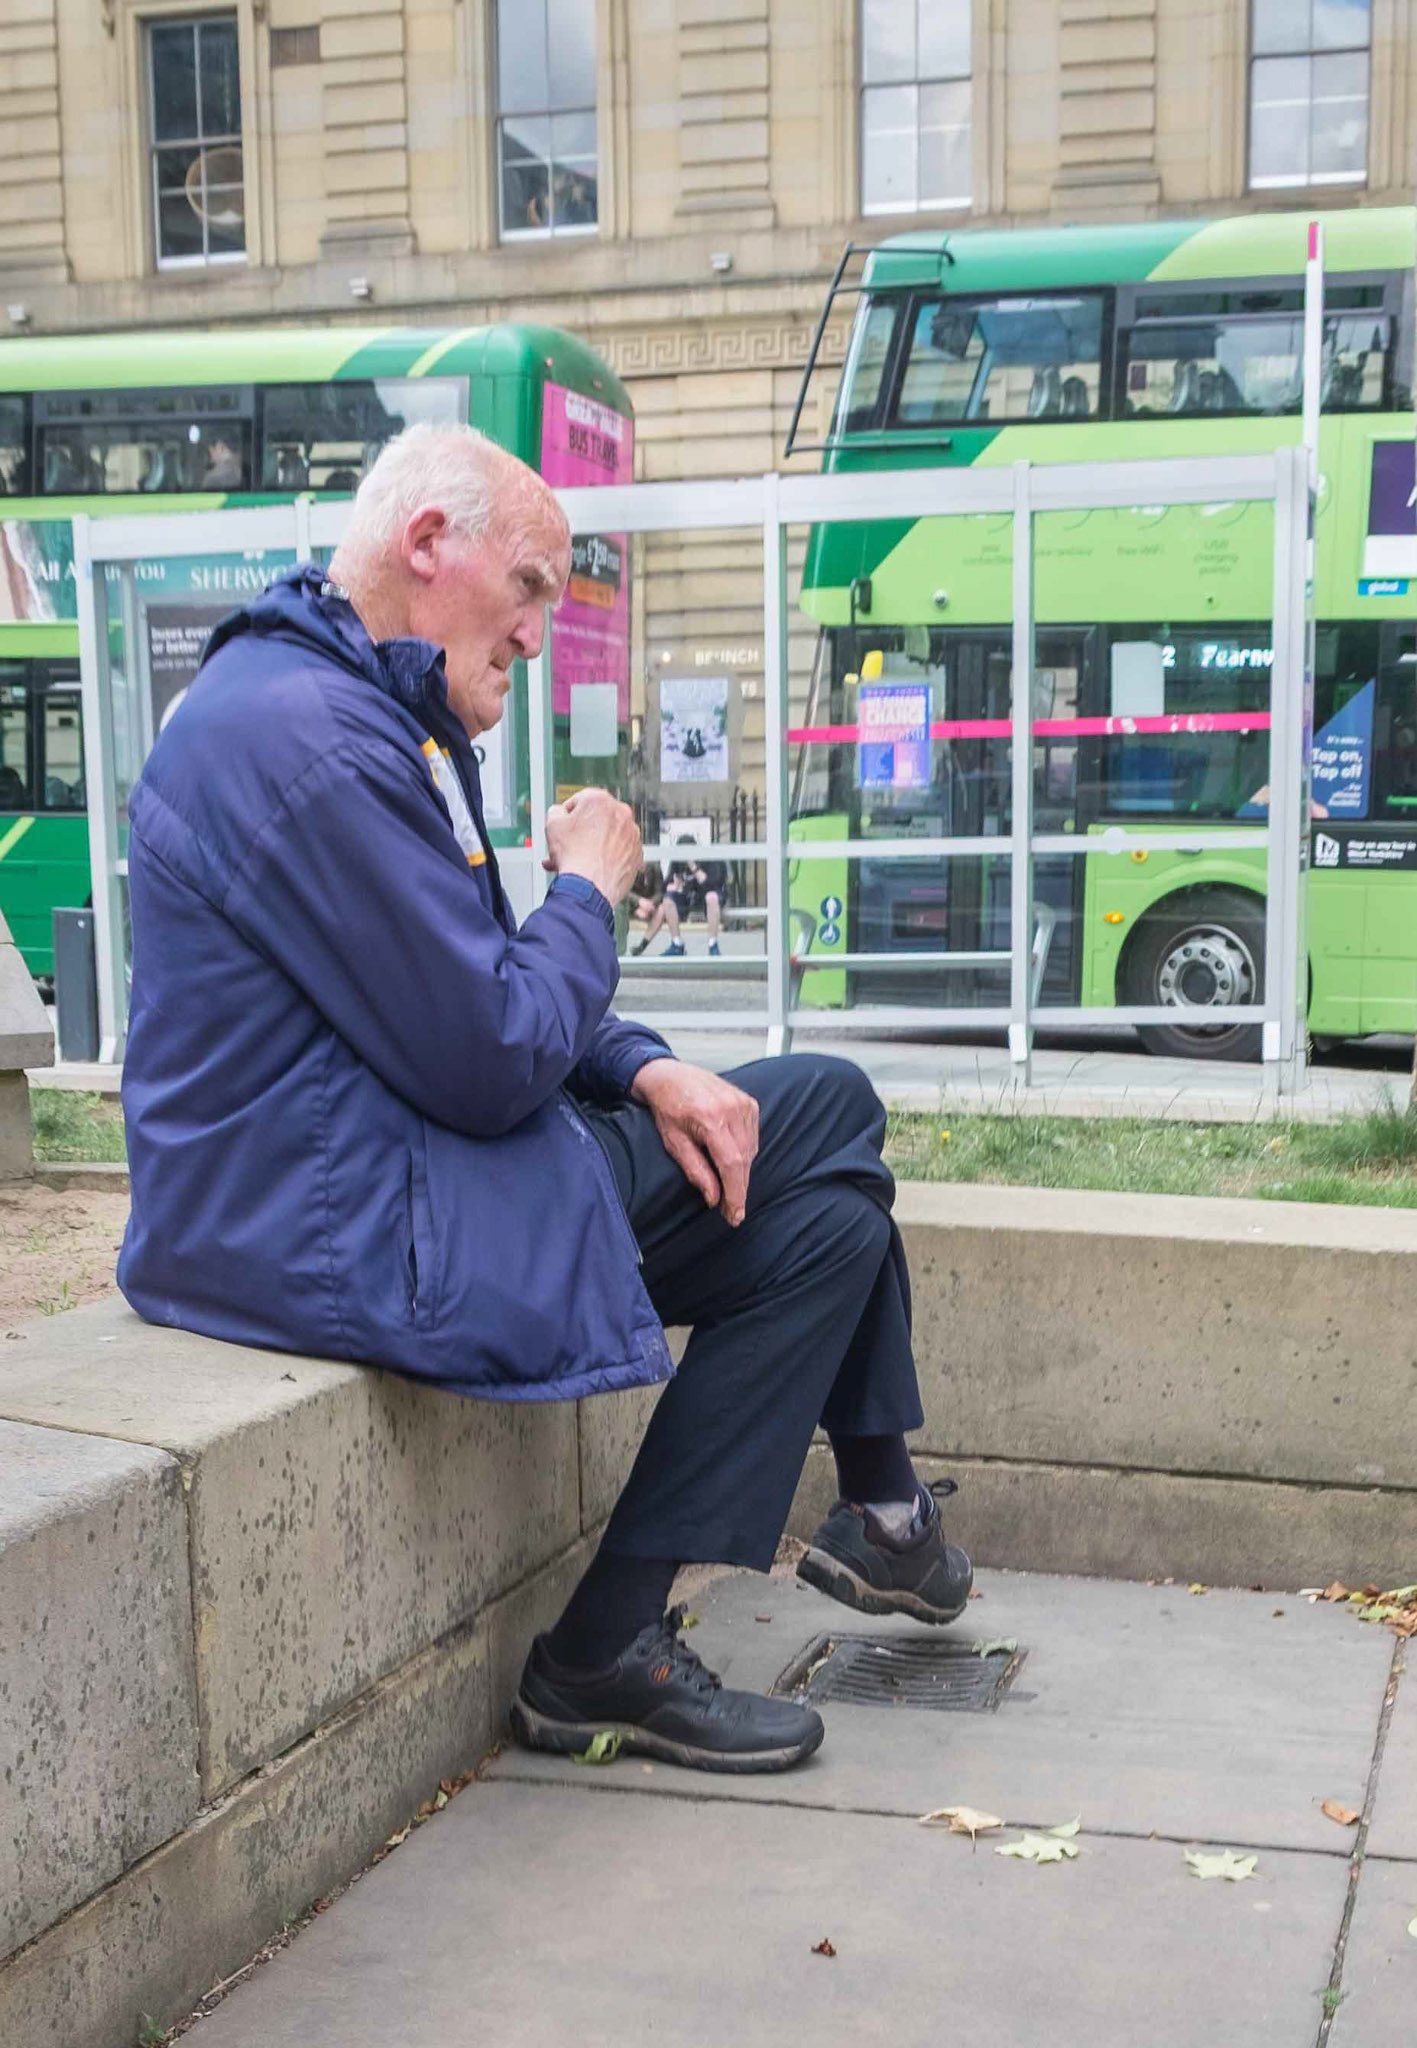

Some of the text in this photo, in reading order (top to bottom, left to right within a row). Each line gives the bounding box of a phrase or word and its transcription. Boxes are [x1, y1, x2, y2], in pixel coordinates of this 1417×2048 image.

[568, 424, 620, 467] BUS TRAVEL
[1312, 748, 1363, 764] Tap on,
[1313, 763, 1362, 781] Tap off
